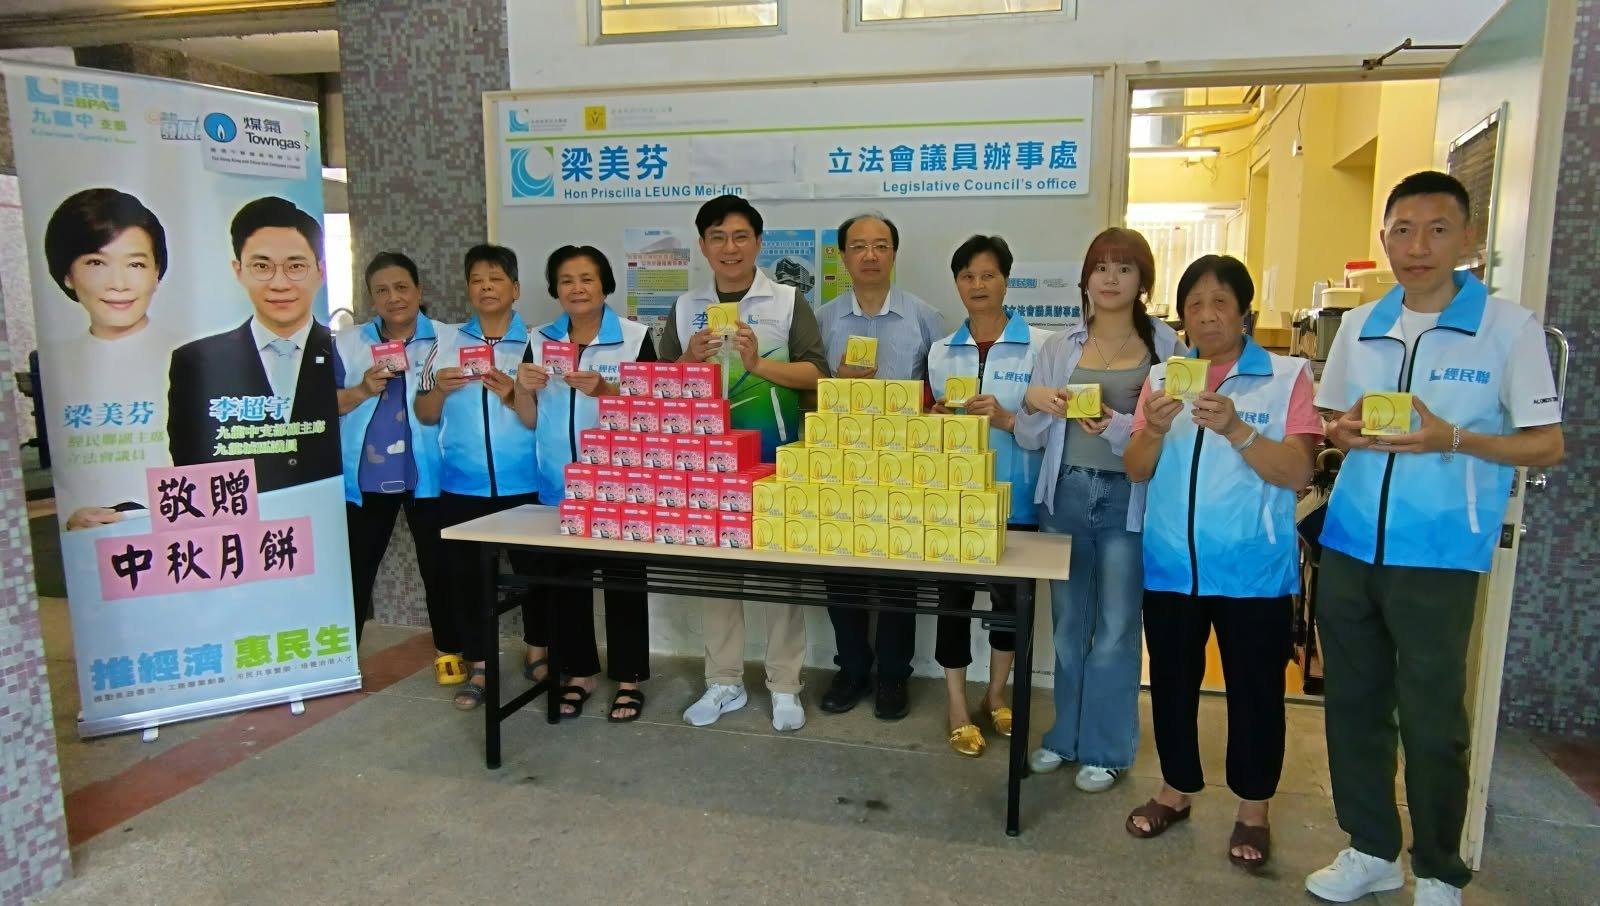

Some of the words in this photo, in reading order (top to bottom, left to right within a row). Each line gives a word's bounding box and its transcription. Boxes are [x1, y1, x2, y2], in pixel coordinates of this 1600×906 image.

[243, 115, 282, 135] 煤氣
[245, 131, 301, 150] Towngas
[561, 143, 668, 182] 梁美芬
[827, 140, 1078, 174] 立法會議員辦事處
[564, 188, 588, 199] Hon
[591, 186, 641, 199] Priscilla
[645, 185, 691, 198] LEUNG
[695, 184, 743, 197] Mei-fun
[883, 179, 960, 195] Legislative
[964, 178, 1032, 191] Council's
[1037, 177, 1077, 190] office
[692, 311, 709, 330] 李
[1443, 367, 1491, 385] 經民聯
[63, 401, 155, 430] 梁美芬
[209, 395, 290, 424] 李超宇
[157, 468, 250, 523] 敬贈
[111, 526, 298, 591] 中秋月餅
[90, 643, 224, 692] 推經濟
[233, 623, 351, 669] 惠民生
